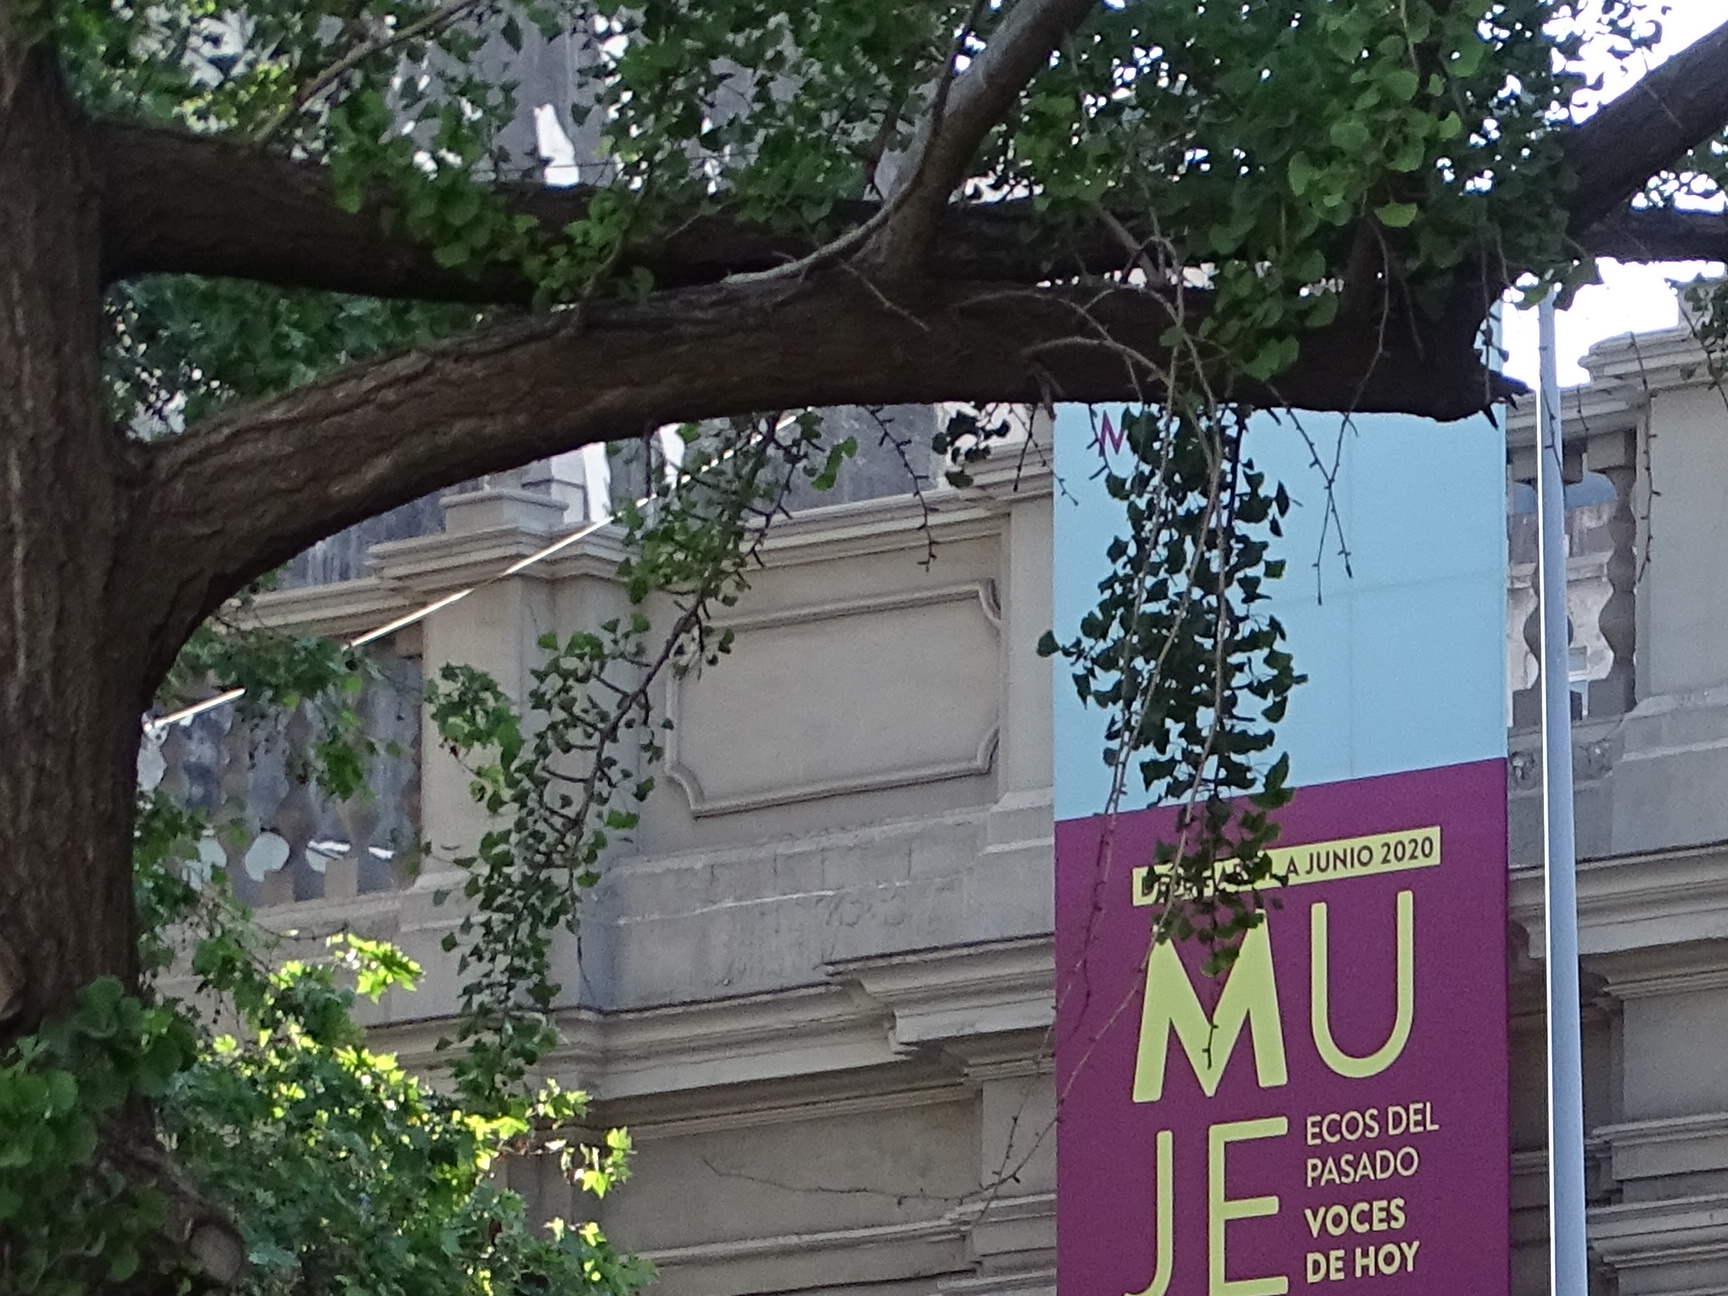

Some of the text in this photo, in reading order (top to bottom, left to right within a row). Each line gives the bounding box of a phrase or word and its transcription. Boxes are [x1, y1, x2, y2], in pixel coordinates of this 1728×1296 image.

[1285, 856, 1300, 877] A
[1305, 845, 1374, 876] JUNIO
[1380, 836, 1434, 865] 2020
[1132, 890, 1414, 1104] MU
[1306, 1101, 1440, 1146] ECOS DEL
[1306, 1145, 1420, 1188] PASADO
[1304, 1197, 1406, 1239] VOCES
[1306, 1239, 1421, 1285] DE HOY
